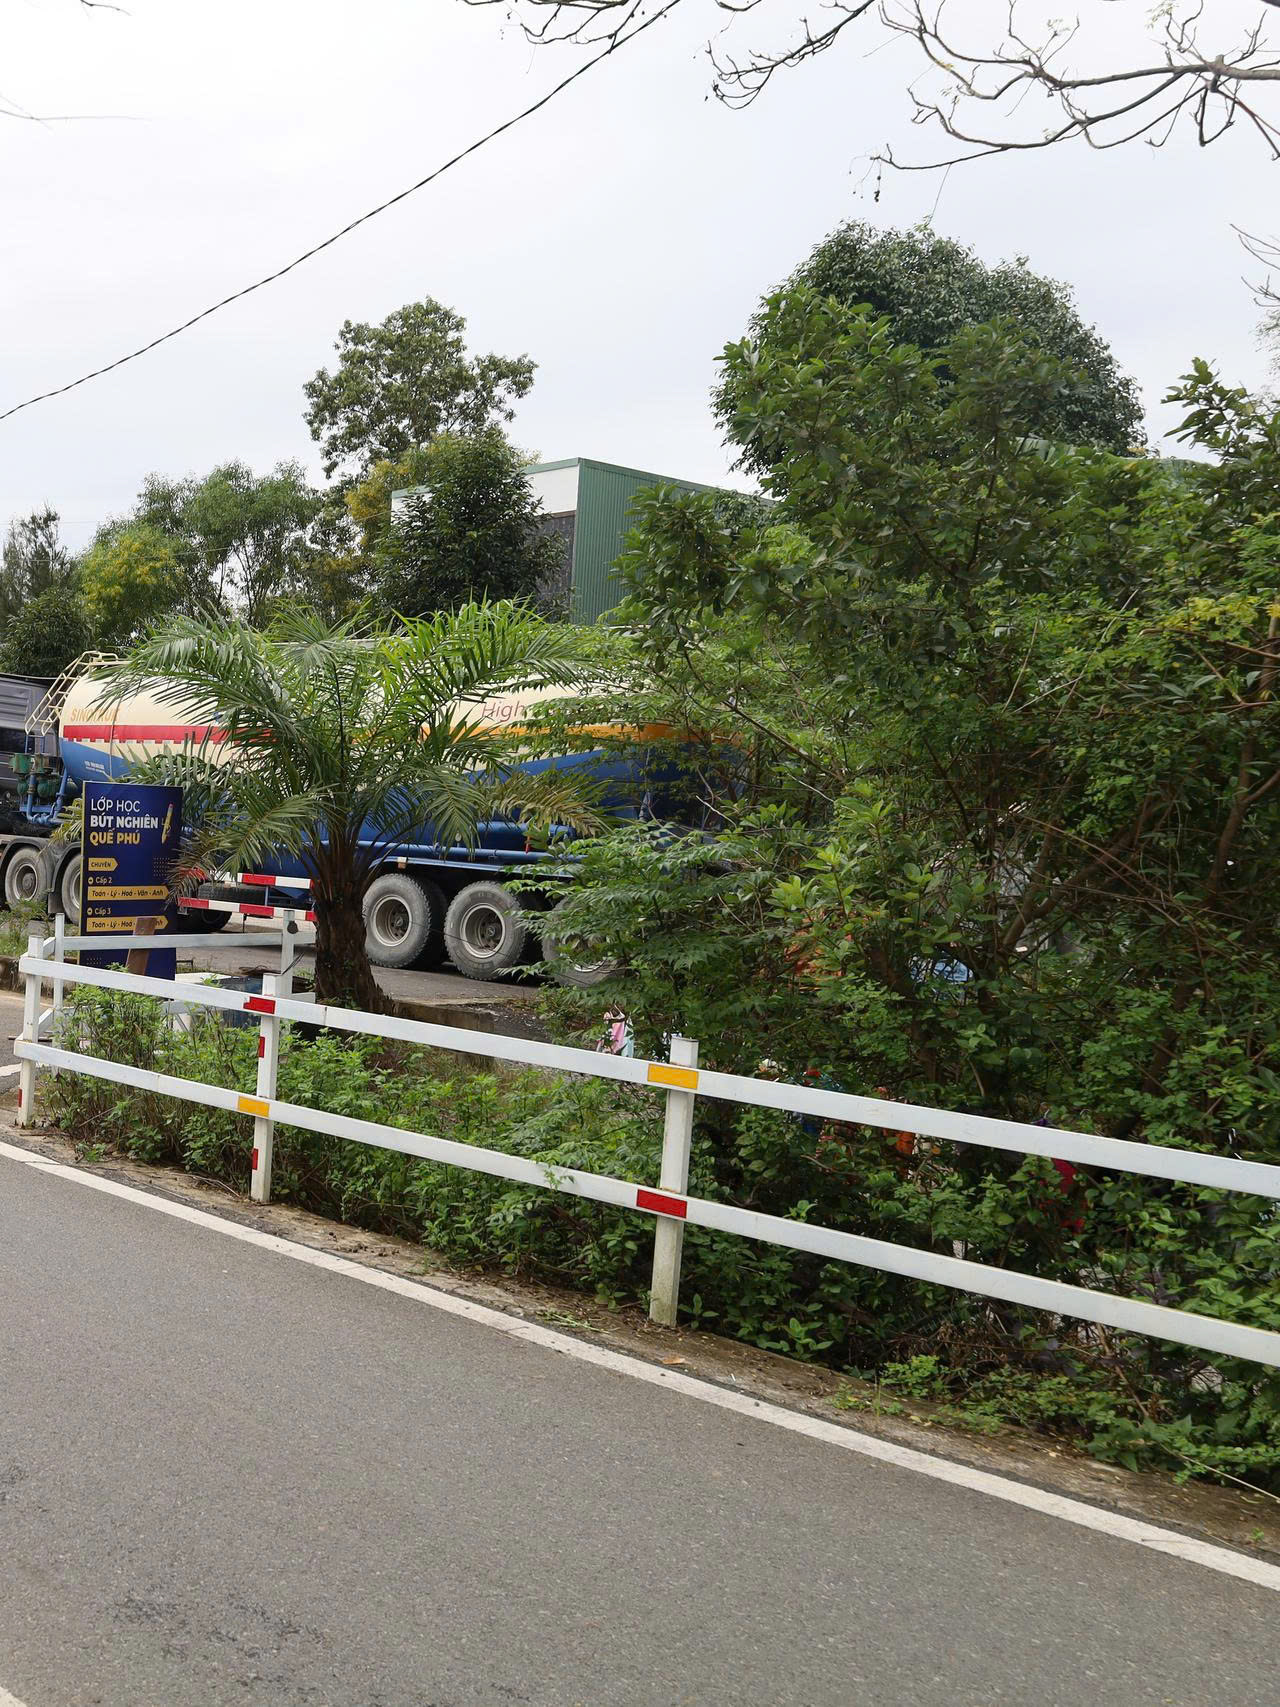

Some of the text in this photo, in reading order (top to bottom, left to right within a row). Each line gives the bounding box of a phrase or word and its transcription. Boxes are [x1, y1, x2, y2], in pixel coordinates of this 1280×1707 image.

[481, 700, 526, 723] High
[91, 796, 141, 816] LỚP HỌC
[90, 812, 159, 829] BÚT NGHIÊN
[89, 827, 141, 846] QUẾ PHÚ
[90, 860, 112, 868] CHUYÊN
[110, 890, 117, 898] Lý
[110, 921, 117, 929] Lý
